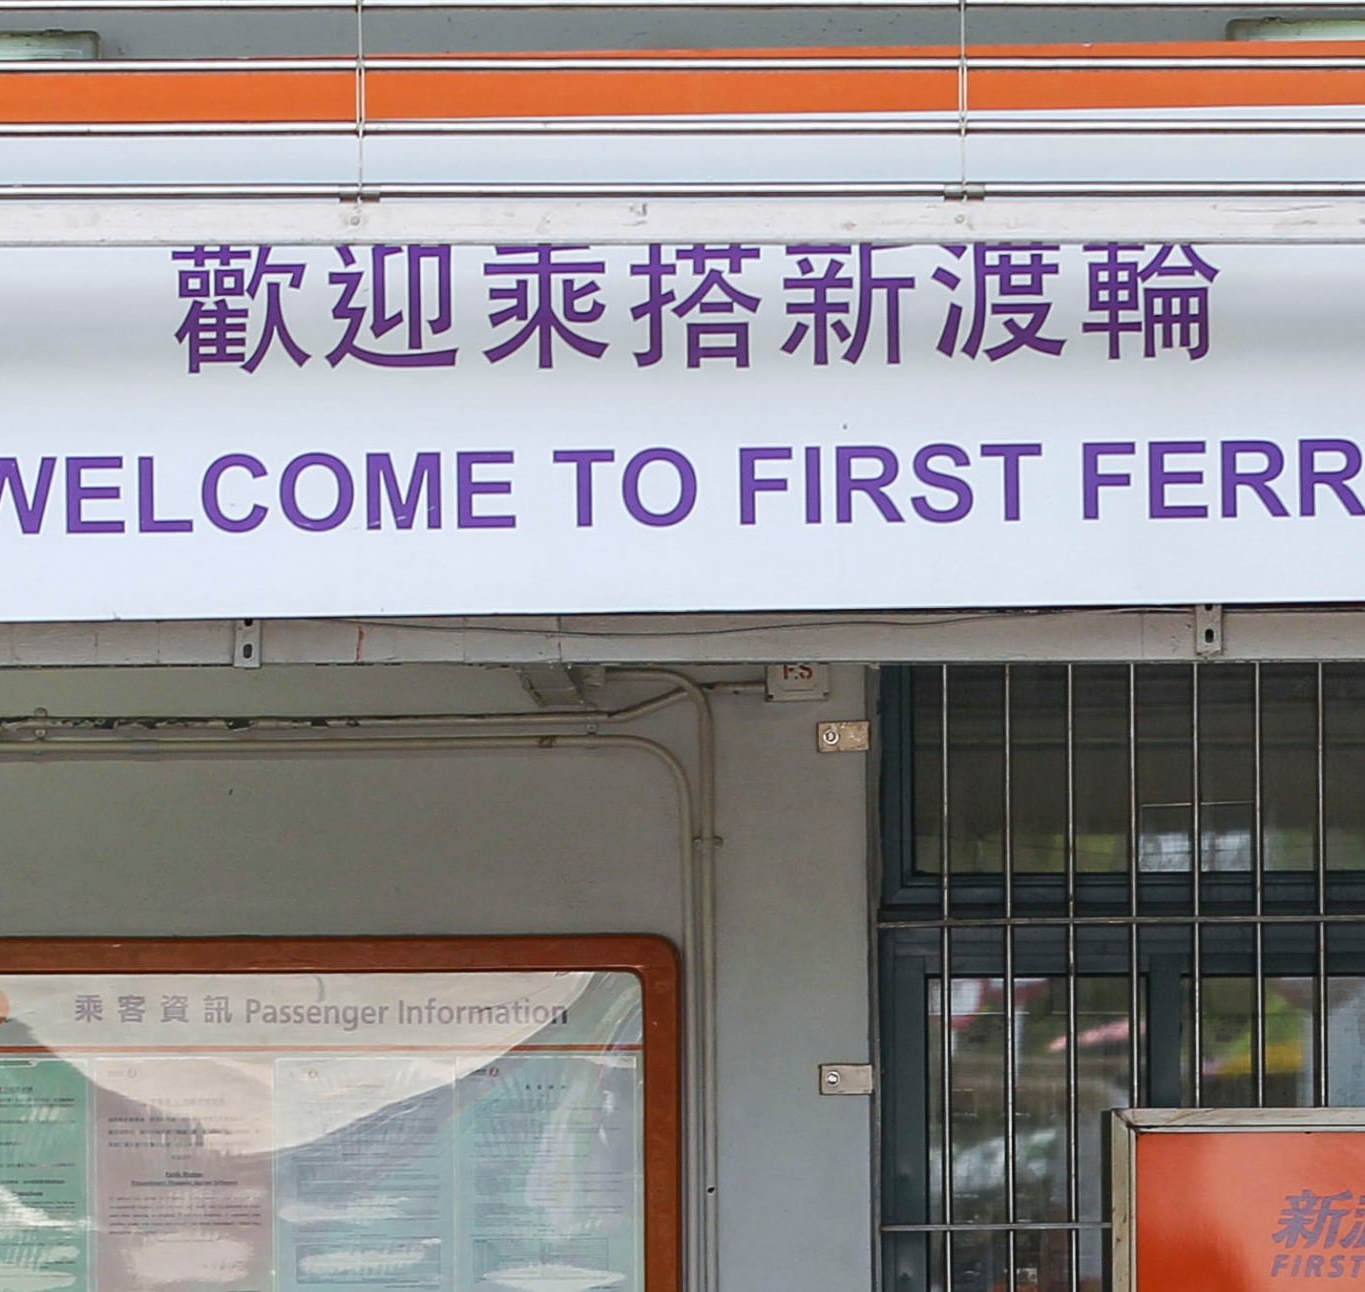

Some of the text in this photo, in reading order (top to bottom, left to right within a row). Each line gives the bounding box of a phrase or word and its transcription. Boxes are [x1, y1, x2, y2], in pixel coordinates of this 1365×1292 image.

[173, 243, 1220, 374] 歡迎乘搭新渡輪
[553, 447, 700, 529] TO
[737, 442, 1044, 526] FIRST
[75, 994, 569, 1031] 乘客資訊 Passenger Information
[1271, 1254, 1365, 1280] FIRST
